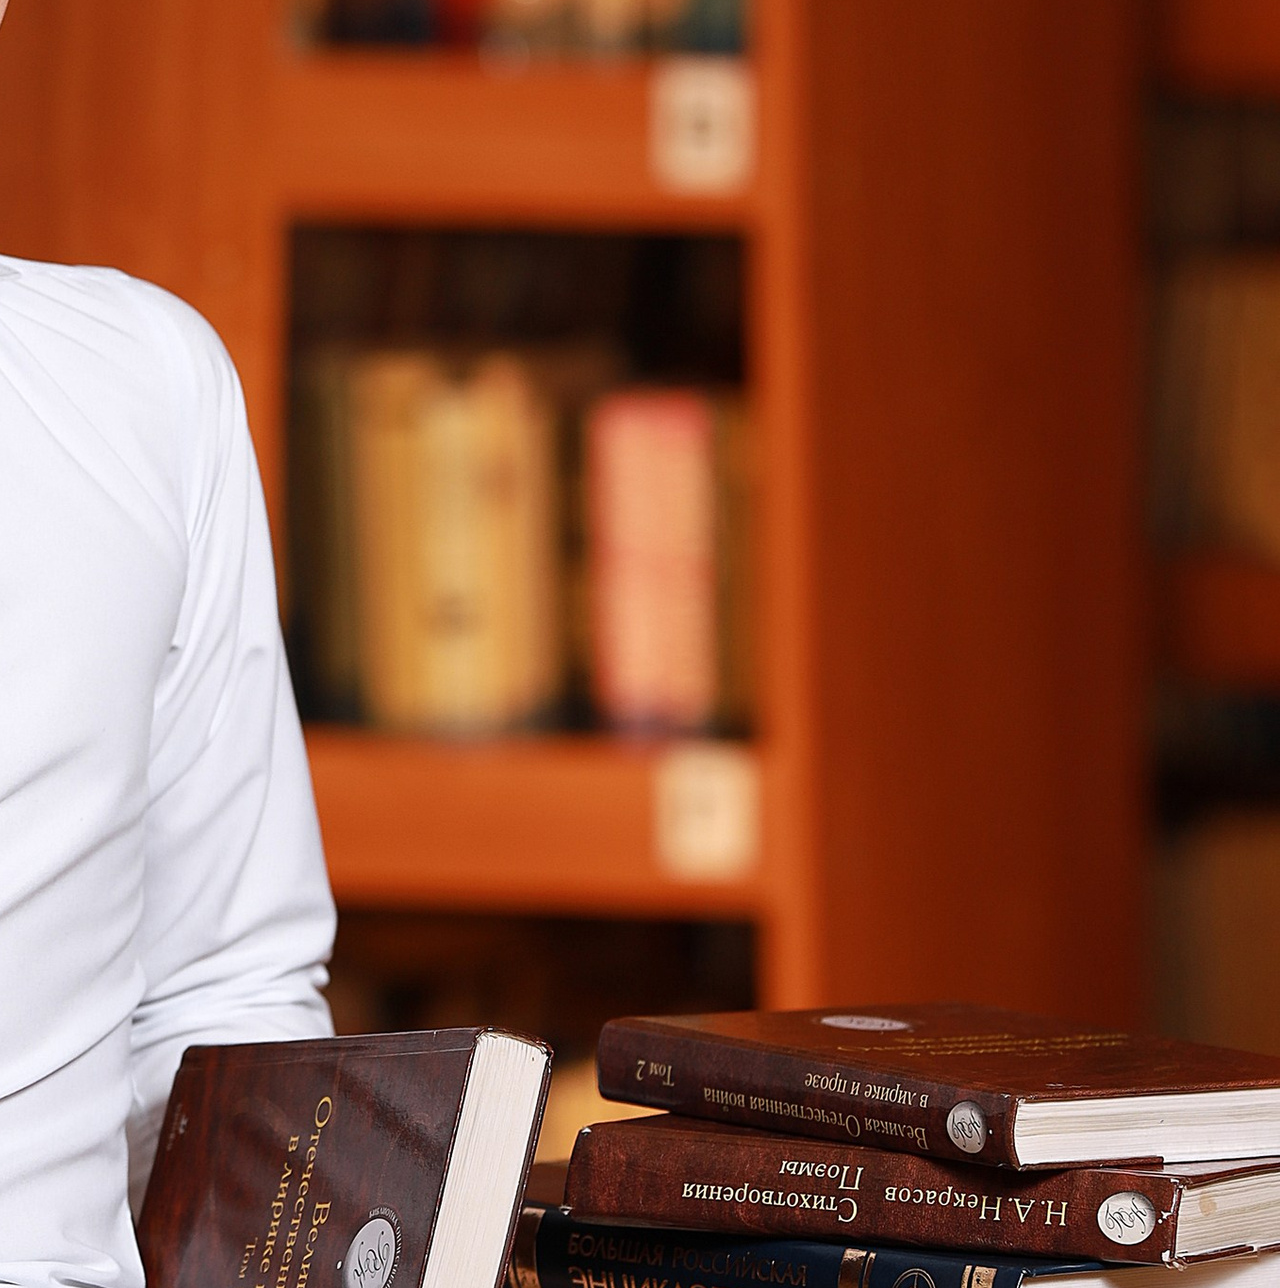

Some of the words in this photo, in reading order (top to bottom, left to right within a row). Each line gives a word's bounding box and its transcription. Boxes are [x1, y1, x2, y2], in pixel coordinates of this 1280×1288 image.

[636, 1060, 646, 1081] 2
[649, 1064, 675, 1087] Том
[805, 1072, 847, 1093] прозе
[704, 1088, 745, 1112] война
[850, 1080, 860, 1094] и
[866, 1082, 917, 1108] лирике
[919, 1094, 929, 1109] в
[749, 1095, 862, 1138] Отечественная
[288, 1135, 299, 1152] в
[864, 1117, 930, 1150] Великая
[779, 1159, 864, 1191] Поэмы
[681, 1181, 858, 1223] Стихотворения
[259, 1162, 293, 1273] лирике
[238, 1237, 258, 1279] Том
[568, 1232, 665, 1264] БОЛЬШАЯ
[672, 1247, 808, 1287] РОССИЙСКАЯ
